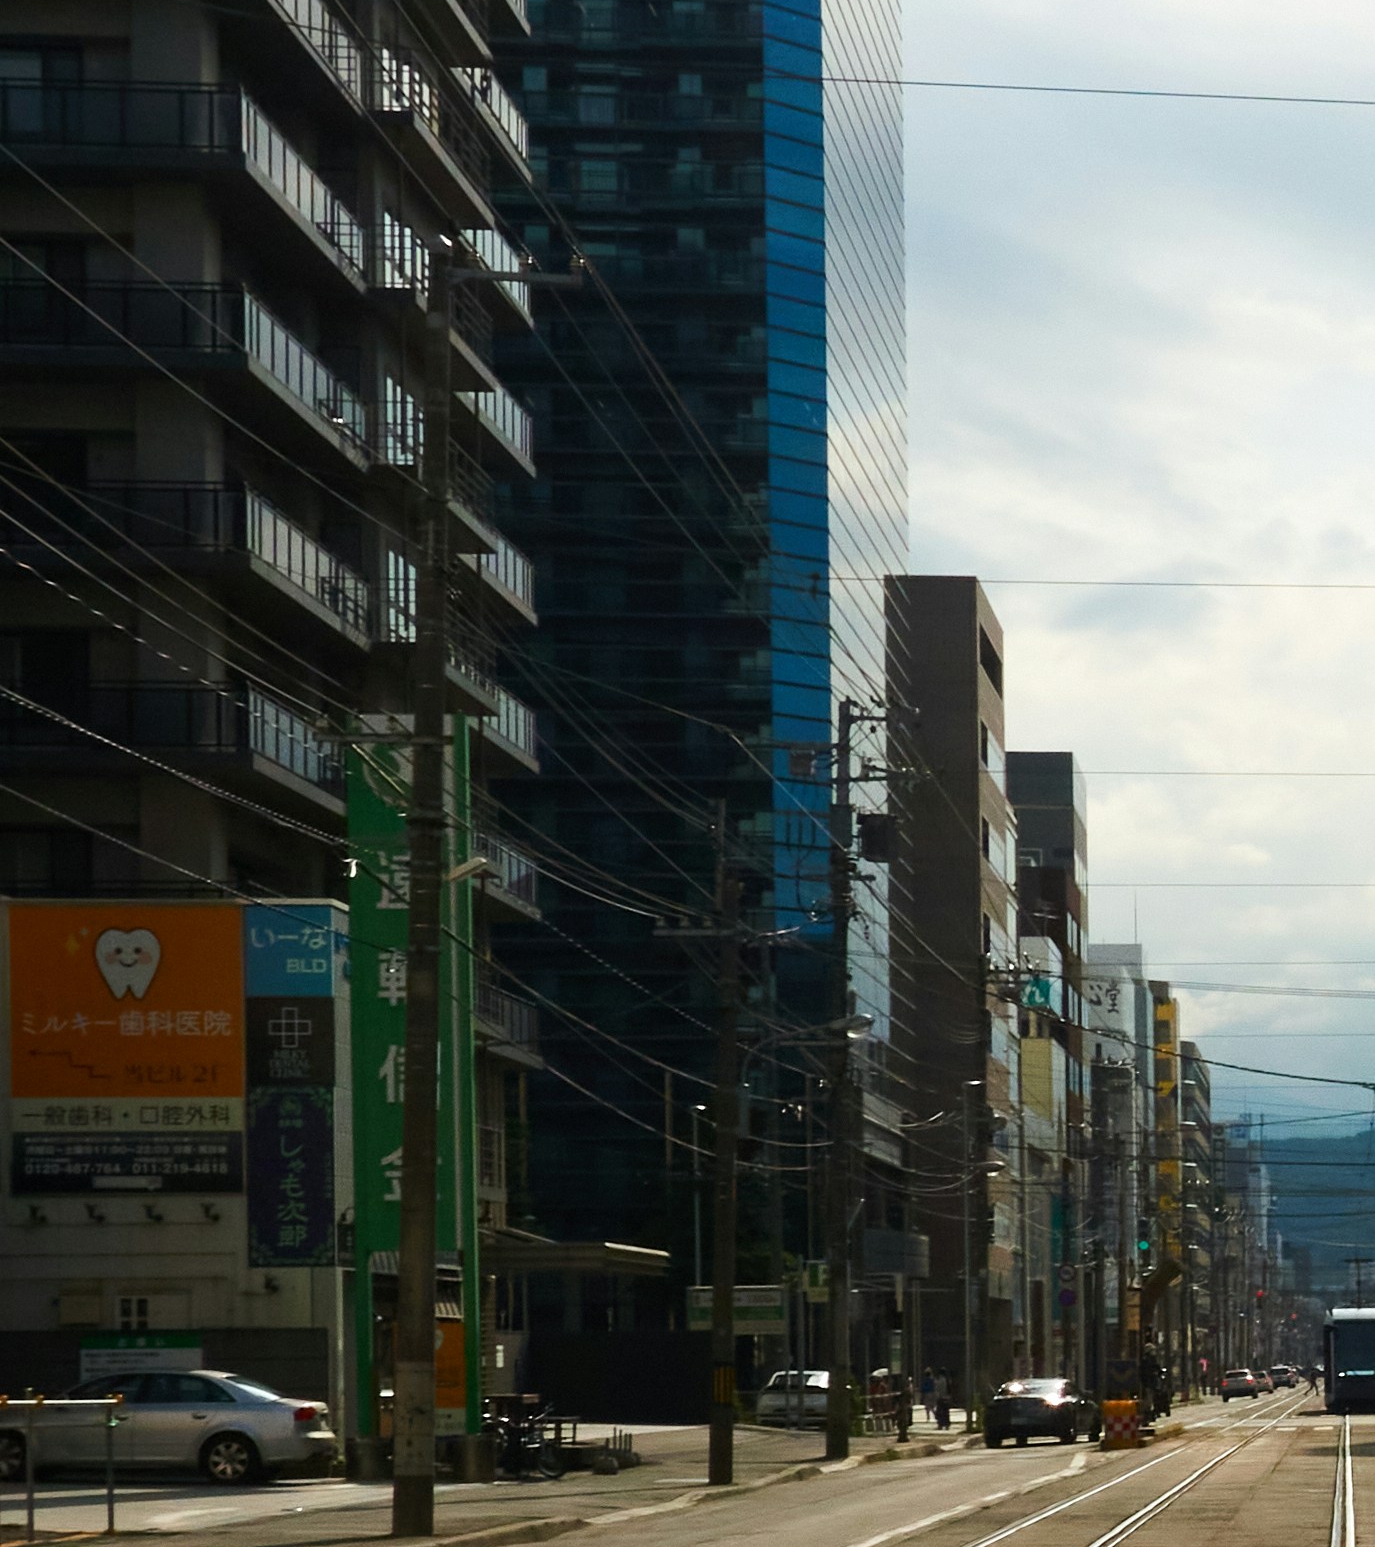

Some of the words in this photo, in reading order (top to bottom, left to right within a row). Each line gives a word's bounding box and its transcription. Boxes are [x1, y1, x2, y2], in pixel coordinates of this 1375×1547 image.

[251, 927, 327, 949] いーな
[286, 959, 326, 973] BLD
[22, 1010, 233, 1036] ミルキー歯科医院
[21, 1105, 230, 1126] 一般歯科・口腔外科
